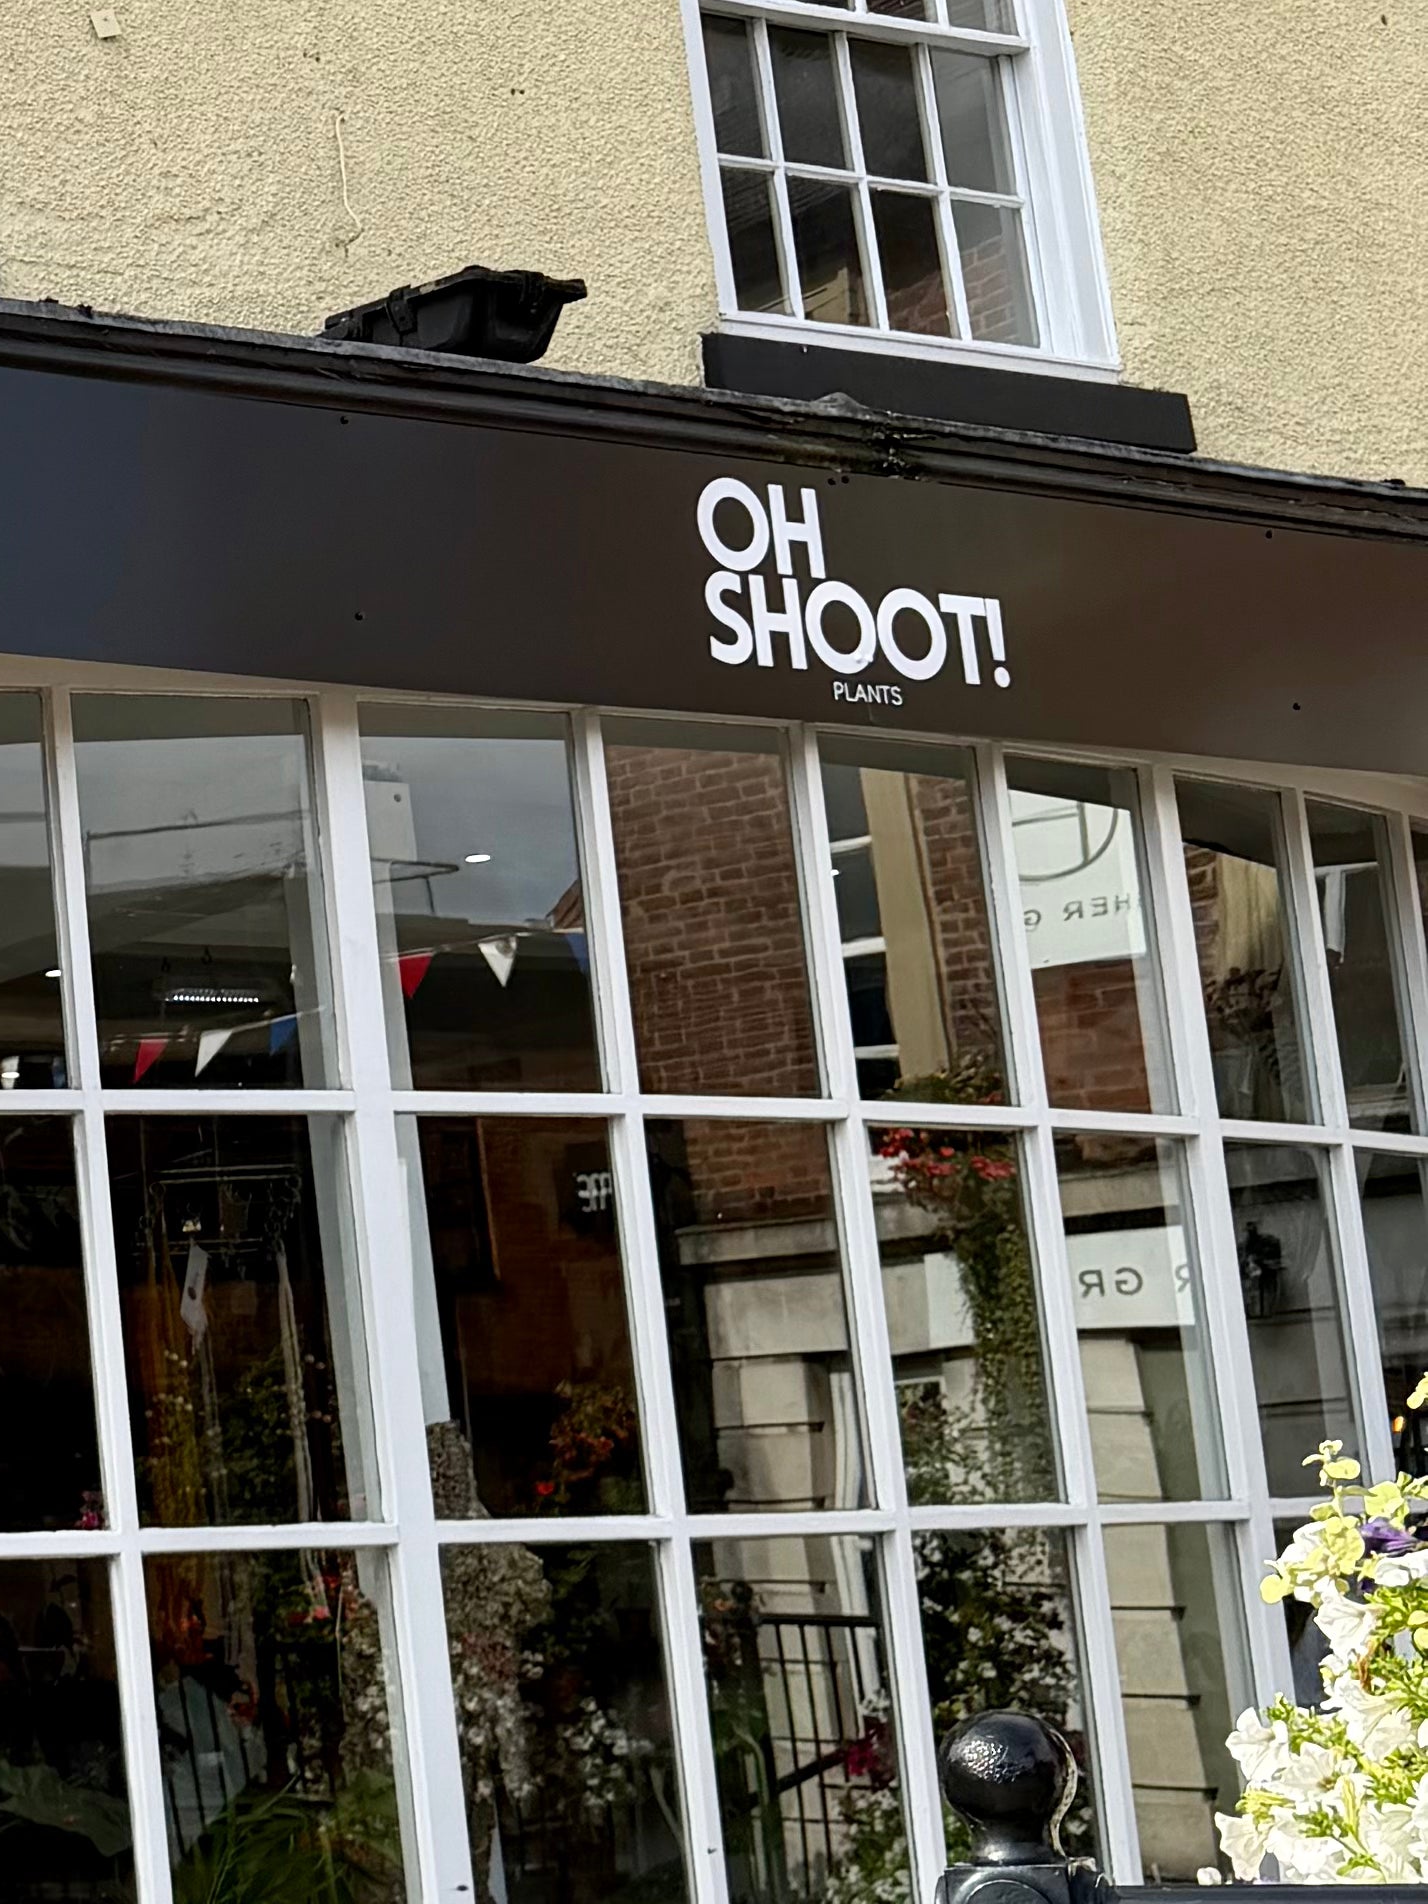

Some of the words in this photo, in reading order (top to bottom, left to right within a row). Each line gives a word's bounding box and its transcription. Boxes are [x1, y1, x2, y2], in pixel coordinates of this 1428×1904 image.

[696, 477, 826, 579] OH
[705, 570, 1011, 688] SHOOT!
[833, 681, 904, 706] PLANTS
